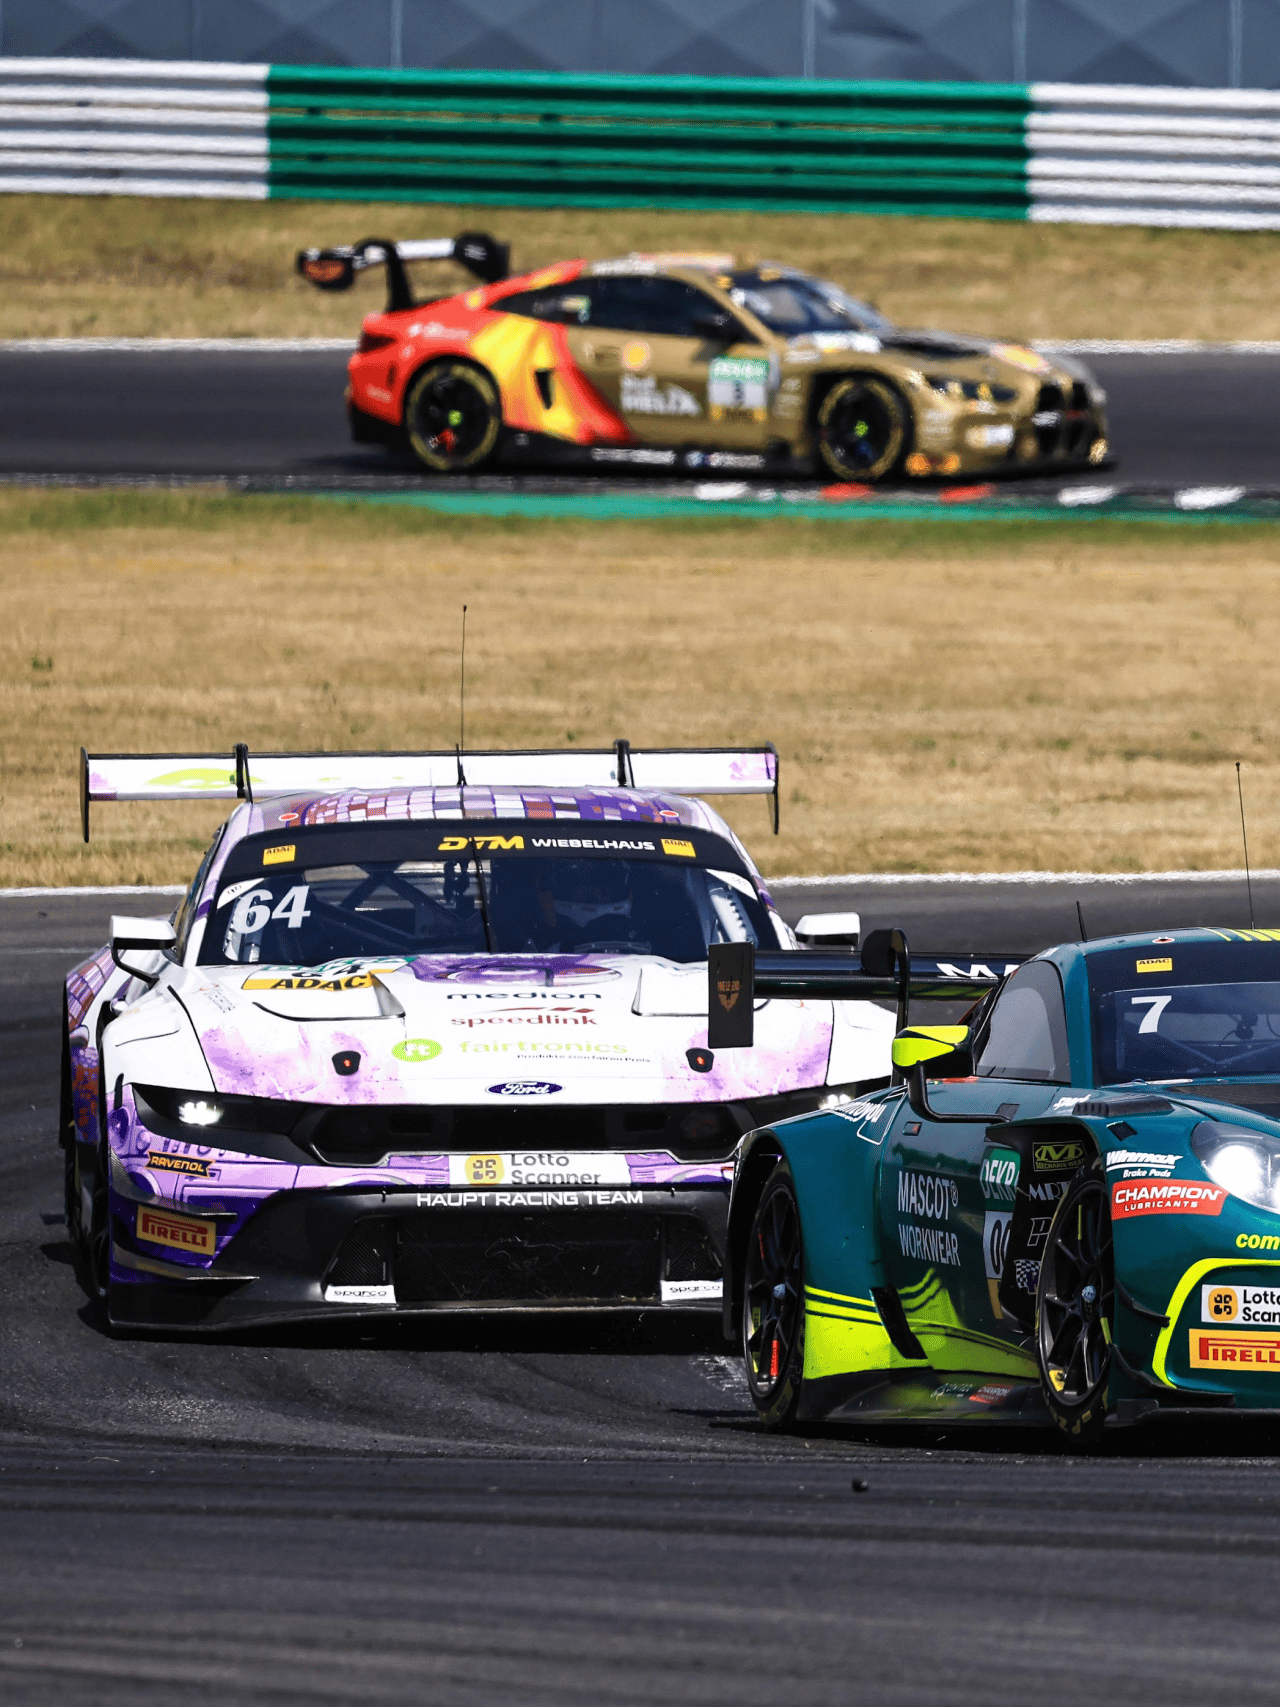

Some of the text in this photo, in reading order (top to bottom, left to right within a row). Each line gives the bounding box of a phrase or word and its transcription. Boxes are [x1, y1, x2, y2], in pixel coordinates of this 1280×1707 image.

[437, 835, 656, 851] DTM WIEBELHAUS
[234, 885, 311, 934] 64
[1138, 957, 1171, 967] ADAC
[271, 975, 368, 991] ADAC
[447, 991, 602, 1000] medion
[450, 1014, 598, 1028] speedlink
[1131, 995, 1172, 1034] 7
[459, 1040, 628, 1054] fairtronics
[501, 1081, 550, 1095] Ford
[150, 1156, 205, 1172] RAVENOL
[511, 1153, 570, 1167] Lotto
[1106, 1149, 1184, 1166] Winmax
[511, 1170, 601, 1185] Scanner
[1123, 1168, 1172, 1179] Brake Pads
[416, 1190, 643, 1207] HAUPT RACING TEAM
[1115, 1186, 1223, 1204] CHAMPION
[1124, 1200, 1199, 1212] LUBRICANTS
[142, 1212, 208, 1248] PIRELLI
[898, 1223, 961, 1267] WORKWEAR
[334, 1289, 387, 1298] sparco
[669, 1285, 721, 1295] sparco
